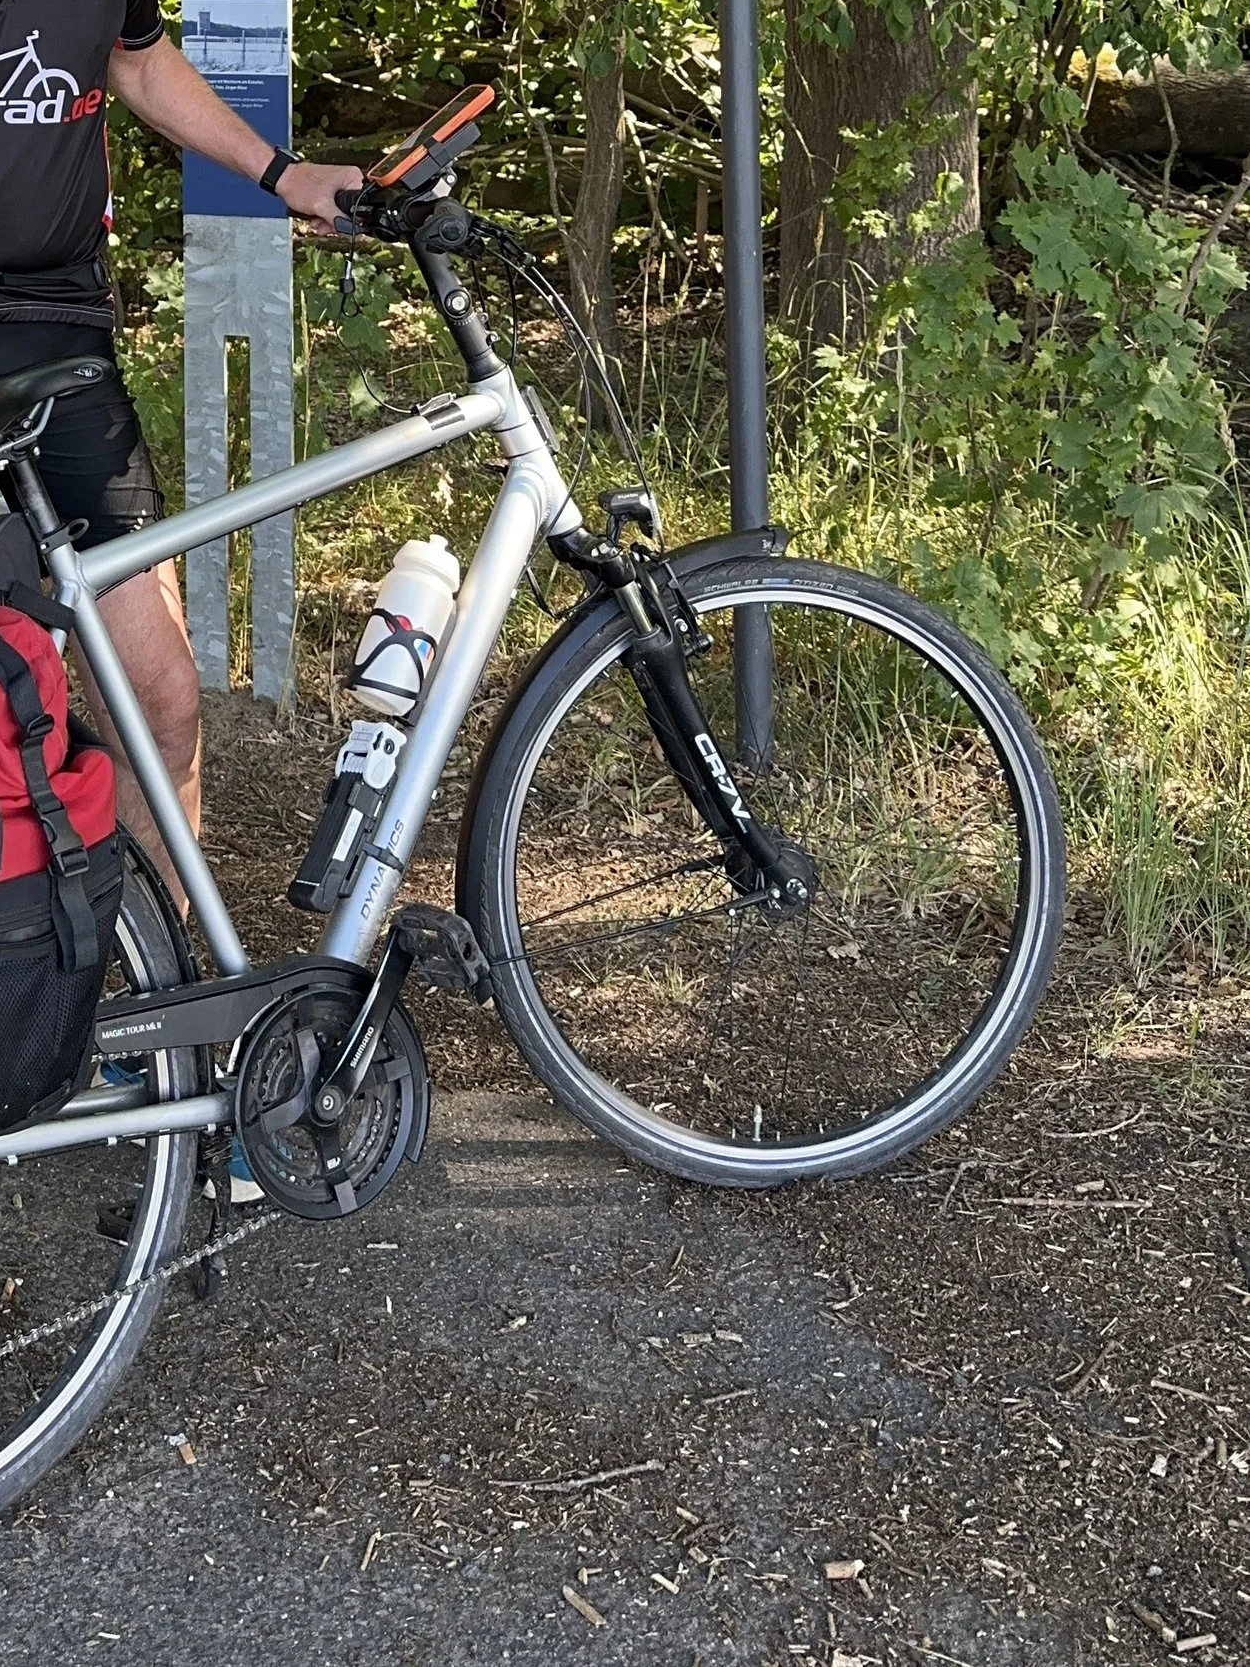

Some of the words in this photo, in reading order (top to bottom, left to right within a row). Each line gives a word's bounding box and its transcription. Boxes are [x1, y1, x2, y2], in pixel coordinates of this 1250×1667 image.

[703, 578, 759, 594] SCHWALBE
[792, 578, 835, 591] CITIZEN
[101, 1028, 125, 1039] MAGIC
[125, 1024, 146, 1035] TOUR
[349, 1025, 375, 1069] SHIMANO
